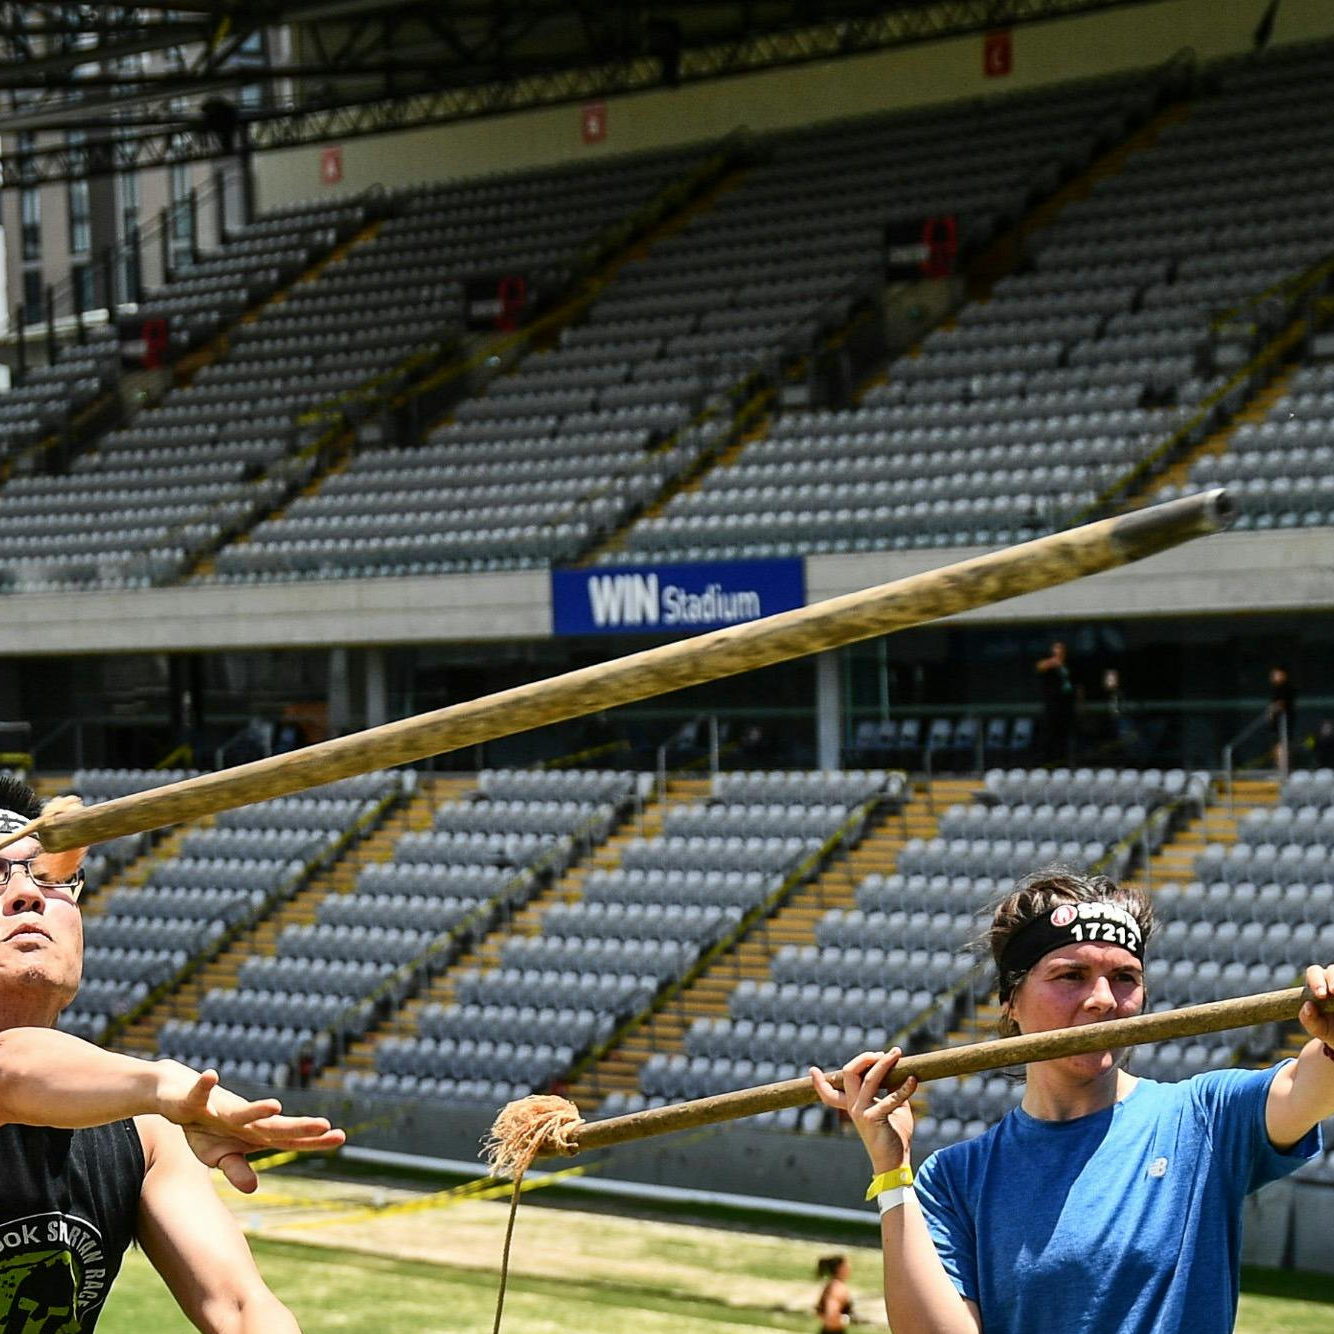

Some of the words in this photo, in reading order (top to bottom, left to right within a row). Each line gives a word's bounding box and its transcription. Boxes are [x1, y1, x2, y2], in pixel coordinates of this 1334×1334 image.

[588, 573, 659, 627] WIN
[662, 583, 761, 625] Stadium
[1070, 922, 1137, 952] 17212
